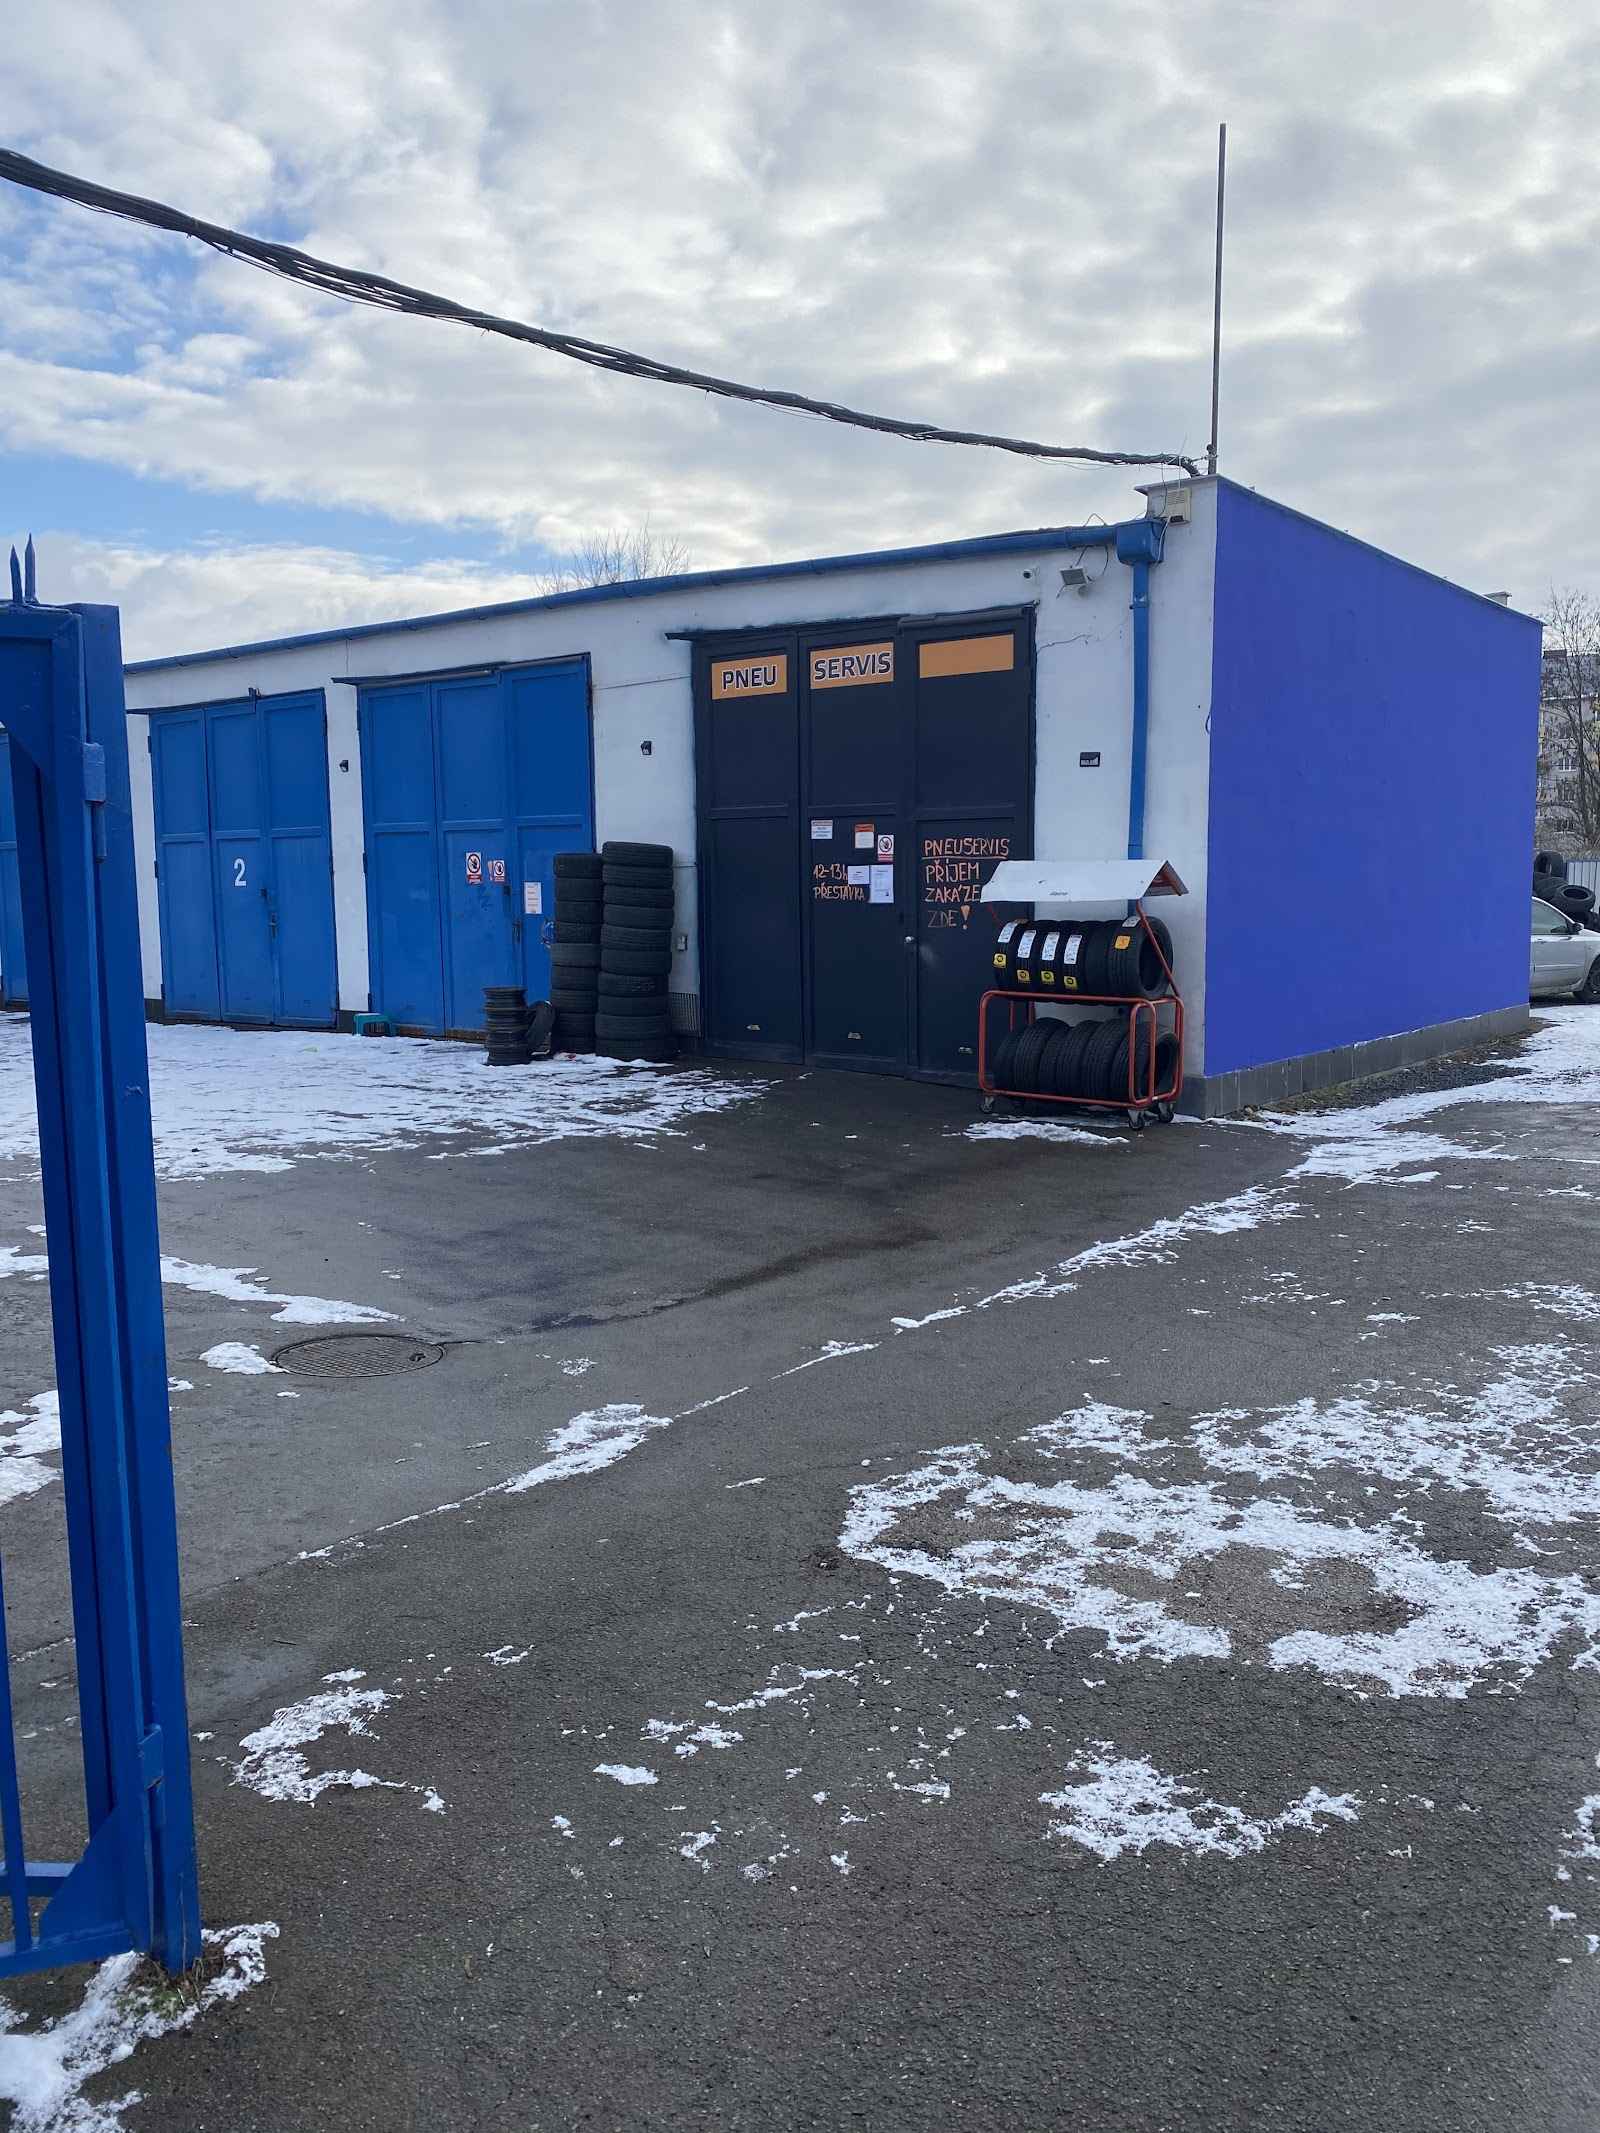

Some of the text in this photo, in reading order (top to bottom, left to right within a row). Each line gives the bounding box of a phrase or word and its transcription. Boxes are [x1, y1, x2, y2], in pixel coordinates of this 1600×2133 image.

[722, 652, 891, 690] PNEU SERVIS
[924, 838, 1010, 856] PNEUSERVIS
[233, 858, 247, 887] 2
[925, 858, 980, 884] PŘÍJEM
[924, 884, 981, 904] ZAKÁZE
